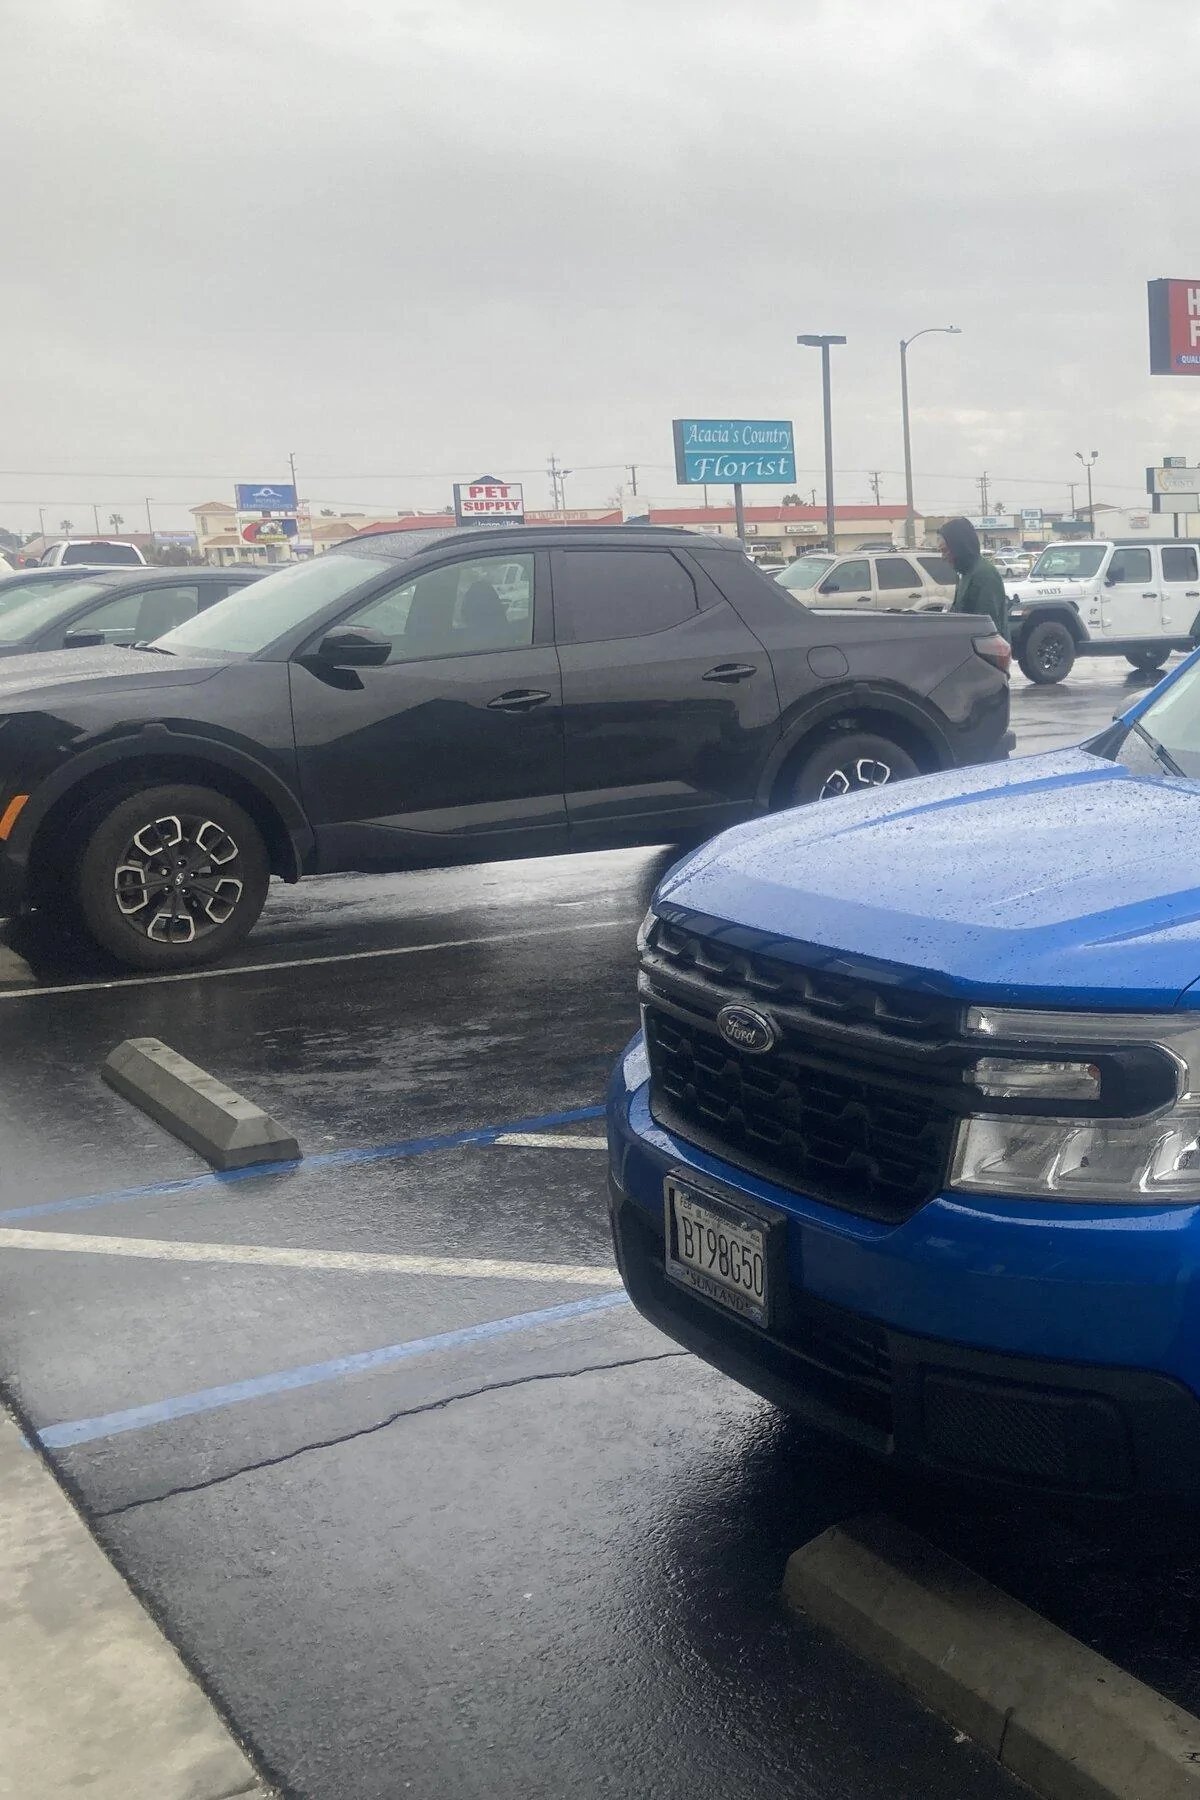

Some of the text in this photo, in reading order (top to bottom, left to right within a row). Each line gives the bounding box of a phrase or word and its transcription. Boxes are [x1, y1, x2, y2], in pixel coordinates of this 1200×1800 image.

[686, 423, 791, 450] Acacia's Country
[690, 454, 789, 482] Florist
[463, 500, 521, 511] SUPPLY
[469, 486, 511, 498] PET
[726, 1015, 756, 1045] Ford
[682, 1216, 764, 1297] BT98G50
[690, 1272, 744, 1311] SUNLAND
